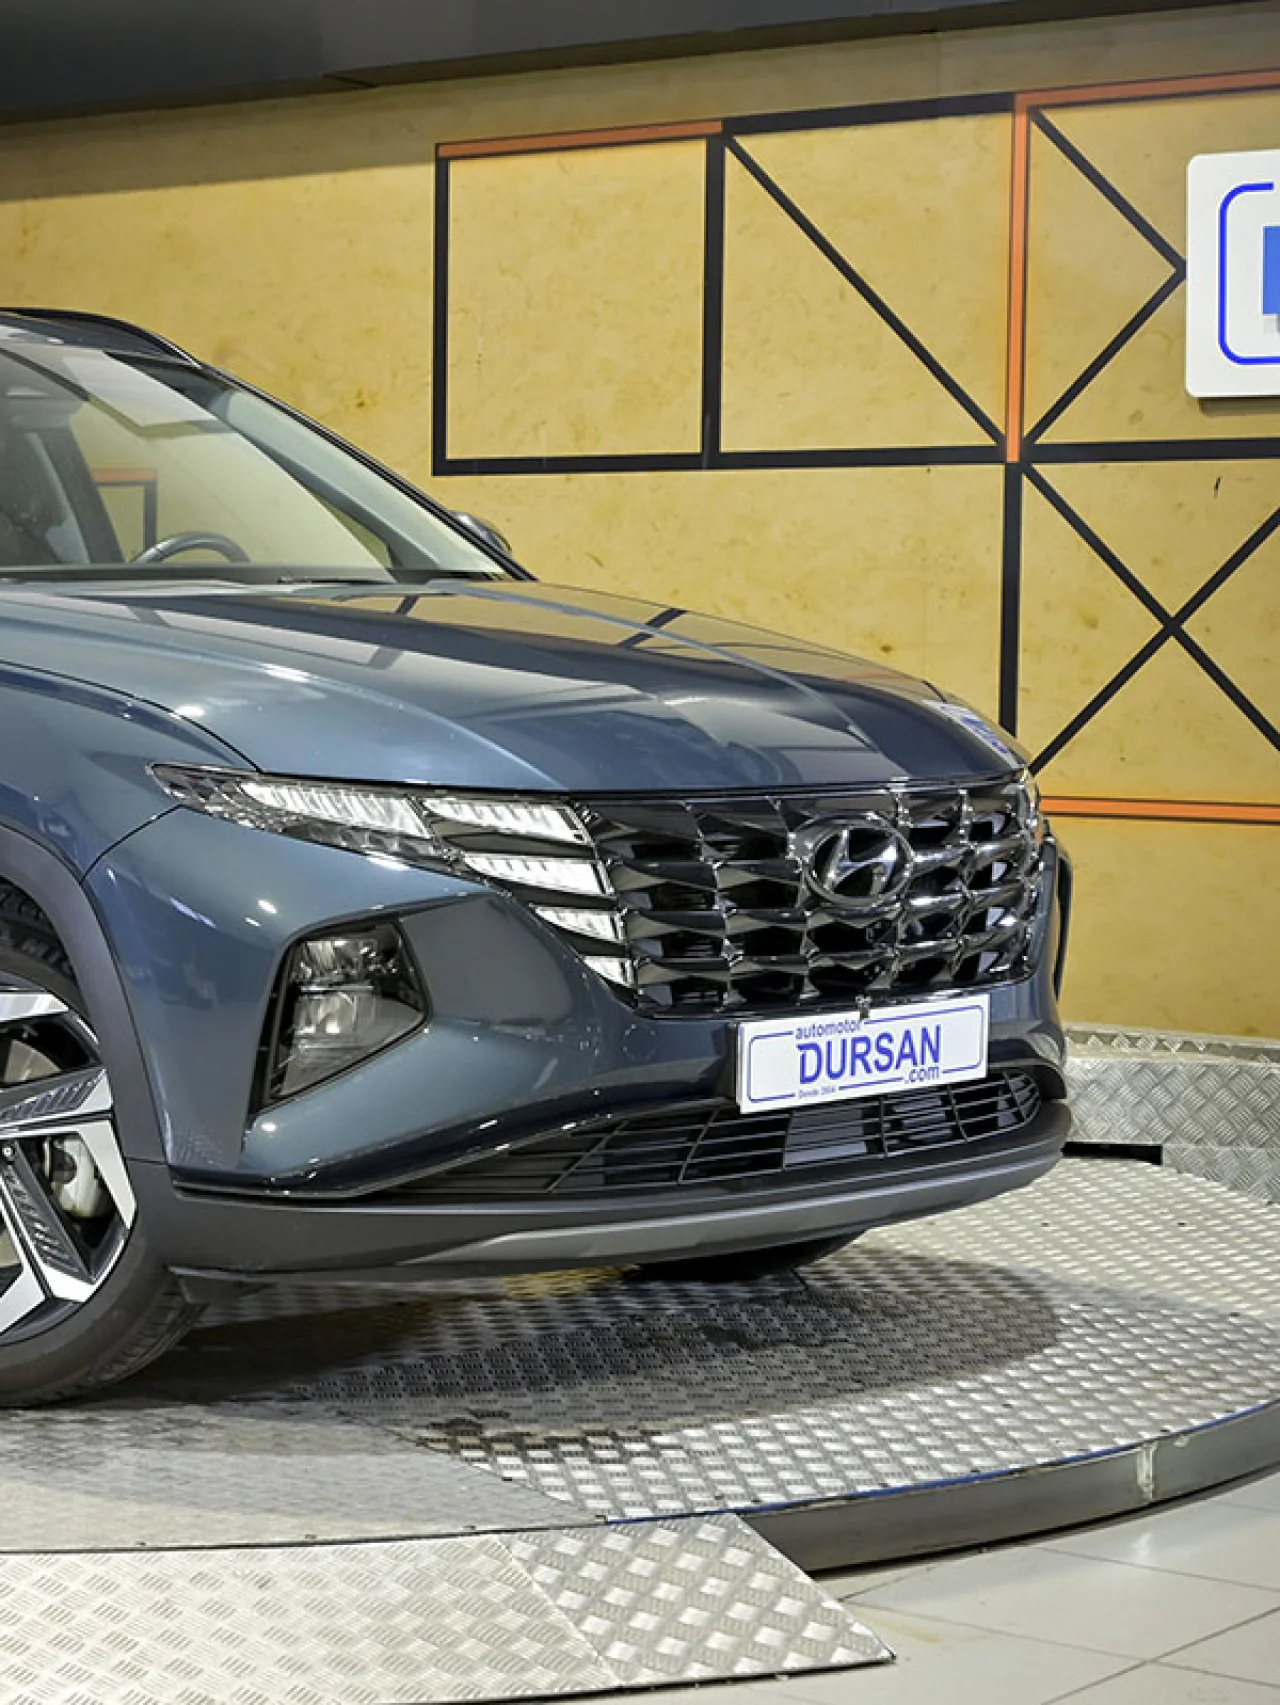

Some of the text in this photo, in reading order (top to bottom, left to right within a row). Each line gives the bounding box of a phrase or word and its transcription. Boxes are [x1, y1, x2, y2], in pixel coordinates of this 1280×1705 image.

[795, 1019, 862, 1040] automotor
[796, 1024, 941, 1084] DURSAN
[903, 1066, 940, 1085] .com
